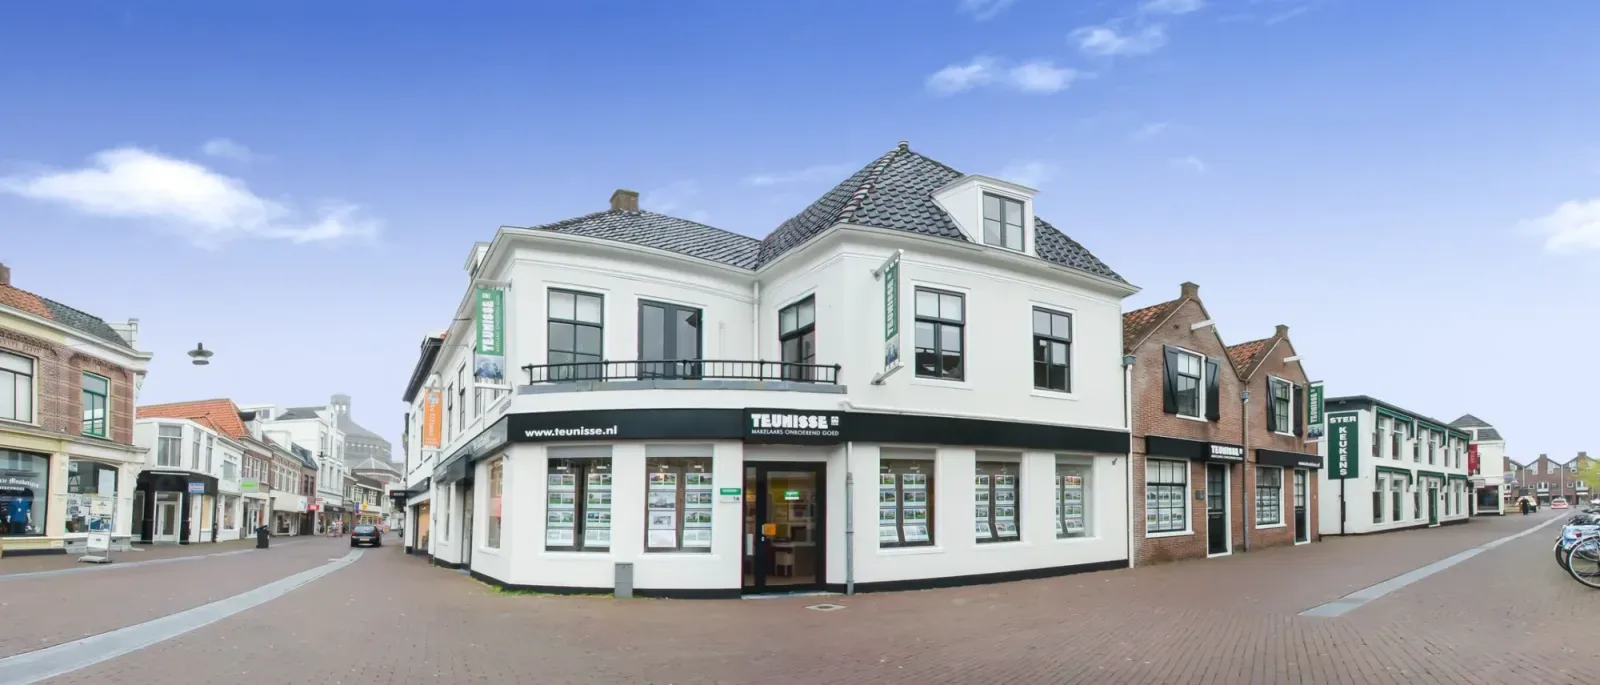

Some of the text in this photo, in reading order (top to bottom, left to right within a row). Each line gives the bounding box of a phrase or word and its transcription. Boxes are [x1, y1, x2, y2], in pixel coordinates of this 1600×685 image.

[482, 300, 494, 352] TEUNISSE
[751, 413, 828, 429] TEUNISSE
[1329, 415, 1357, 424] STER
[525, 425, 618, 437] www.teunisse.nl
[1338, 426, 1348, 476] KEUKENS
